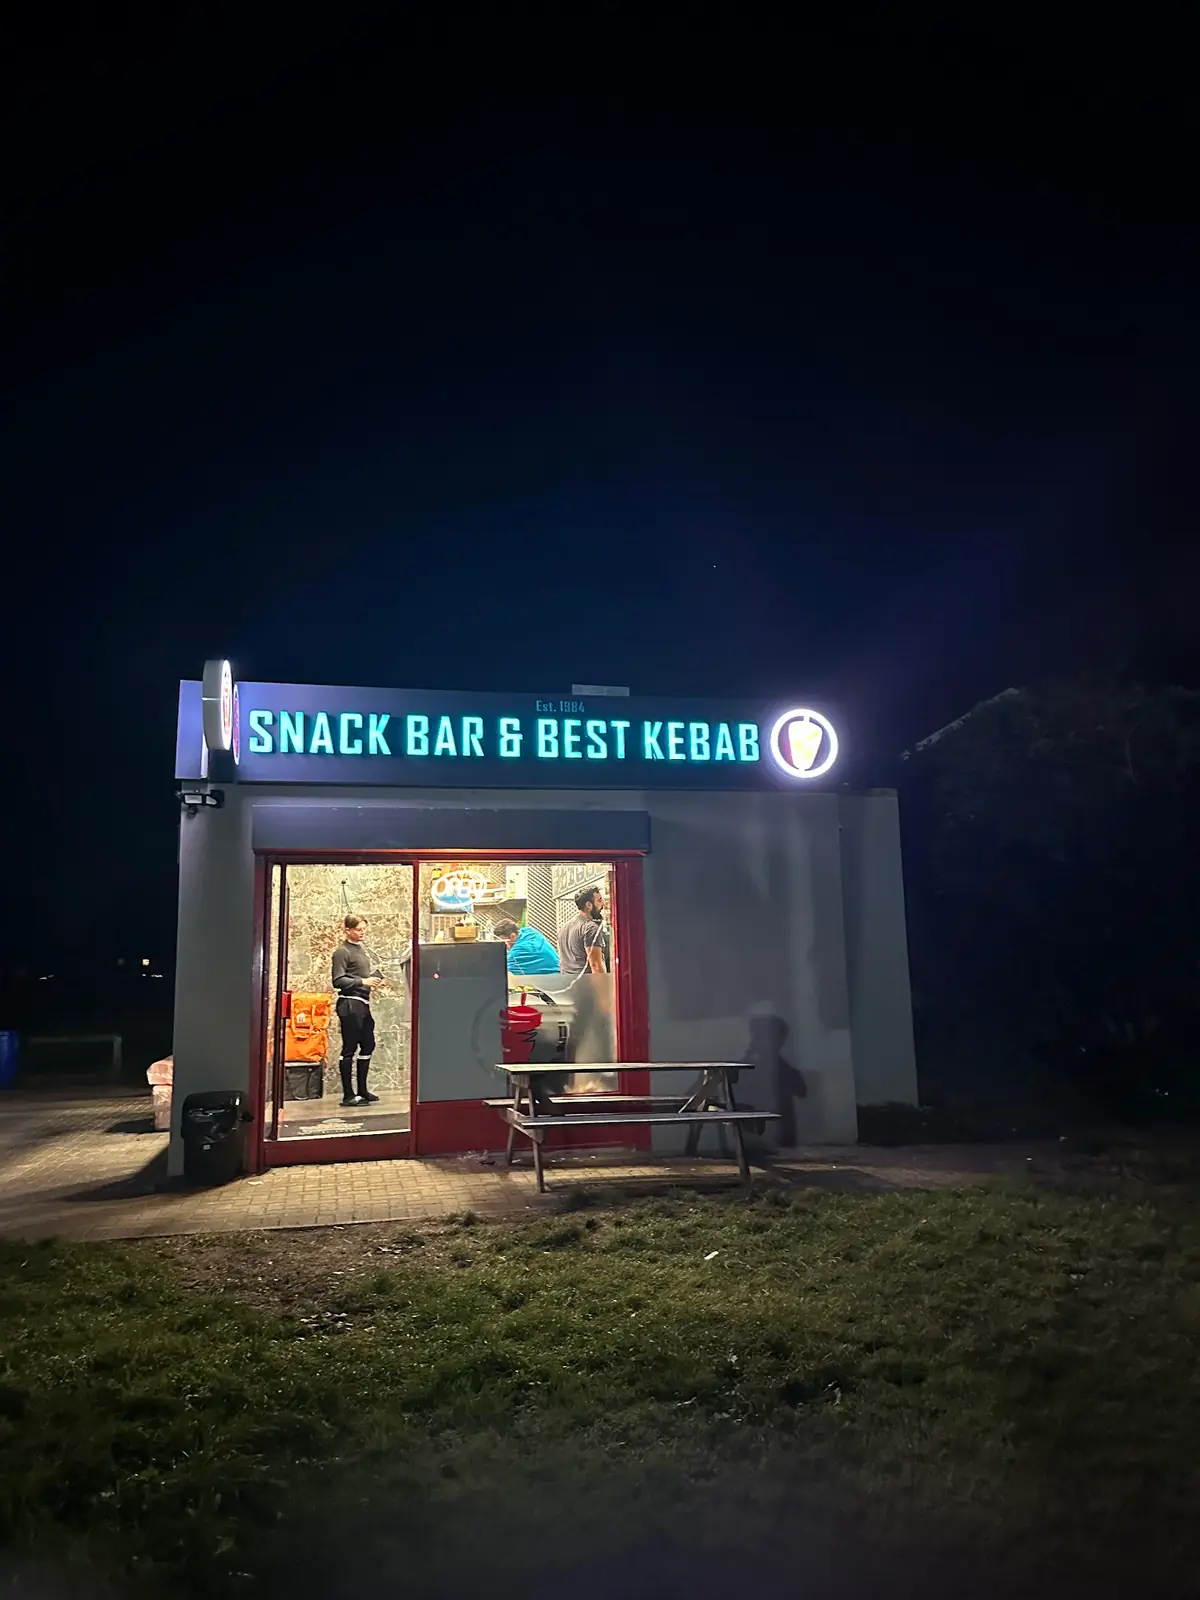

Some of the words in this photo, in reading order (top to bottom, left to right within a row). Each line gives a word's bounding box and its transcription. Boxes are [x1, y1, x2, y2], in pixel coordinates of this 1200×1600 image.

[536, 700, 557, 712] Est.
[559, 700, 585, 713] 1984
[249, 709, 392, 754] SNACK
[407, 715, 484, 756] BAR
[499, 718, 523, 757] &
[537, 718, 631, 759] BEST
[644, 721, 759, 761] KEBAB
